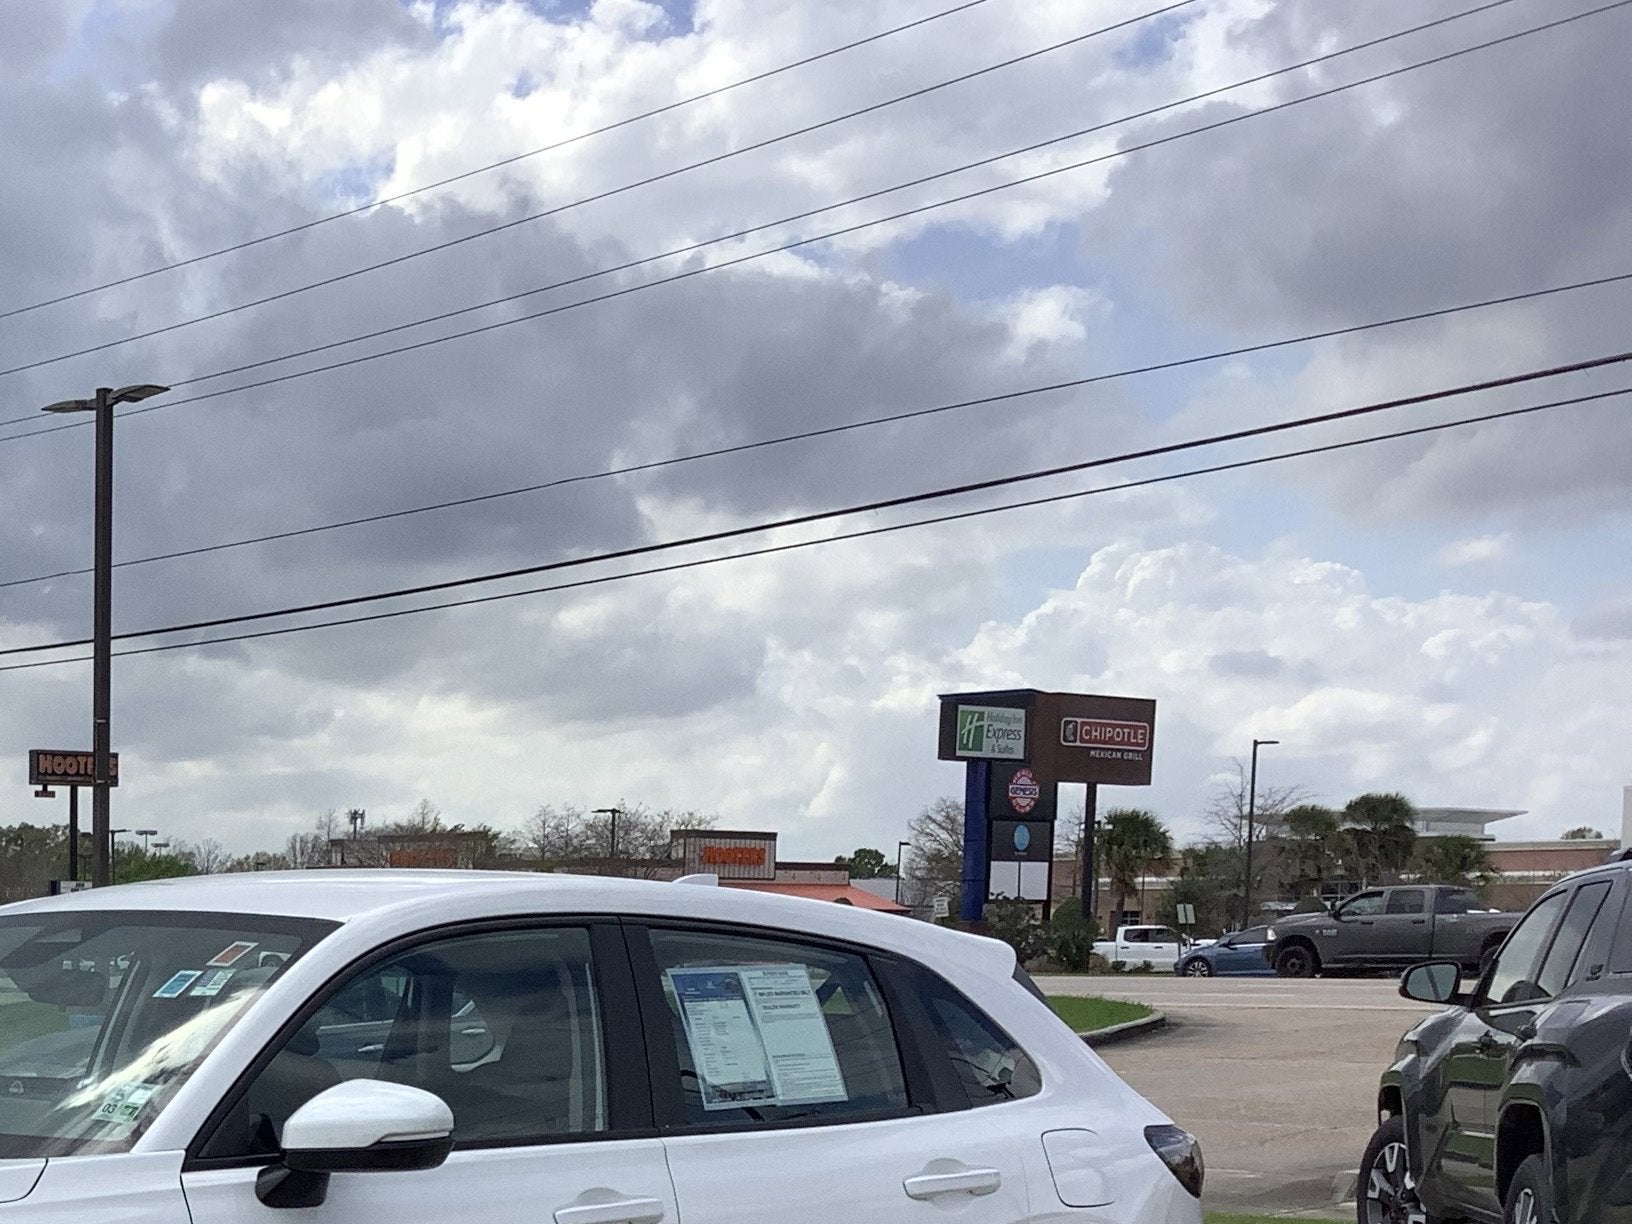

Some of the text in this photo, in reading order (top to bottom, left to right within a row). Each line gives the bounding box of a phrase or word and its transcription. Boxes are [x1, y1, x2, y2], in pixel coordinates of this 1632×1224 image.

[986, 724, 1023, 743] Express
[1082, 725, 1145, 744] CHIPOTLE
[1089, 750, 1143, 761] MEXICAN GRILL
